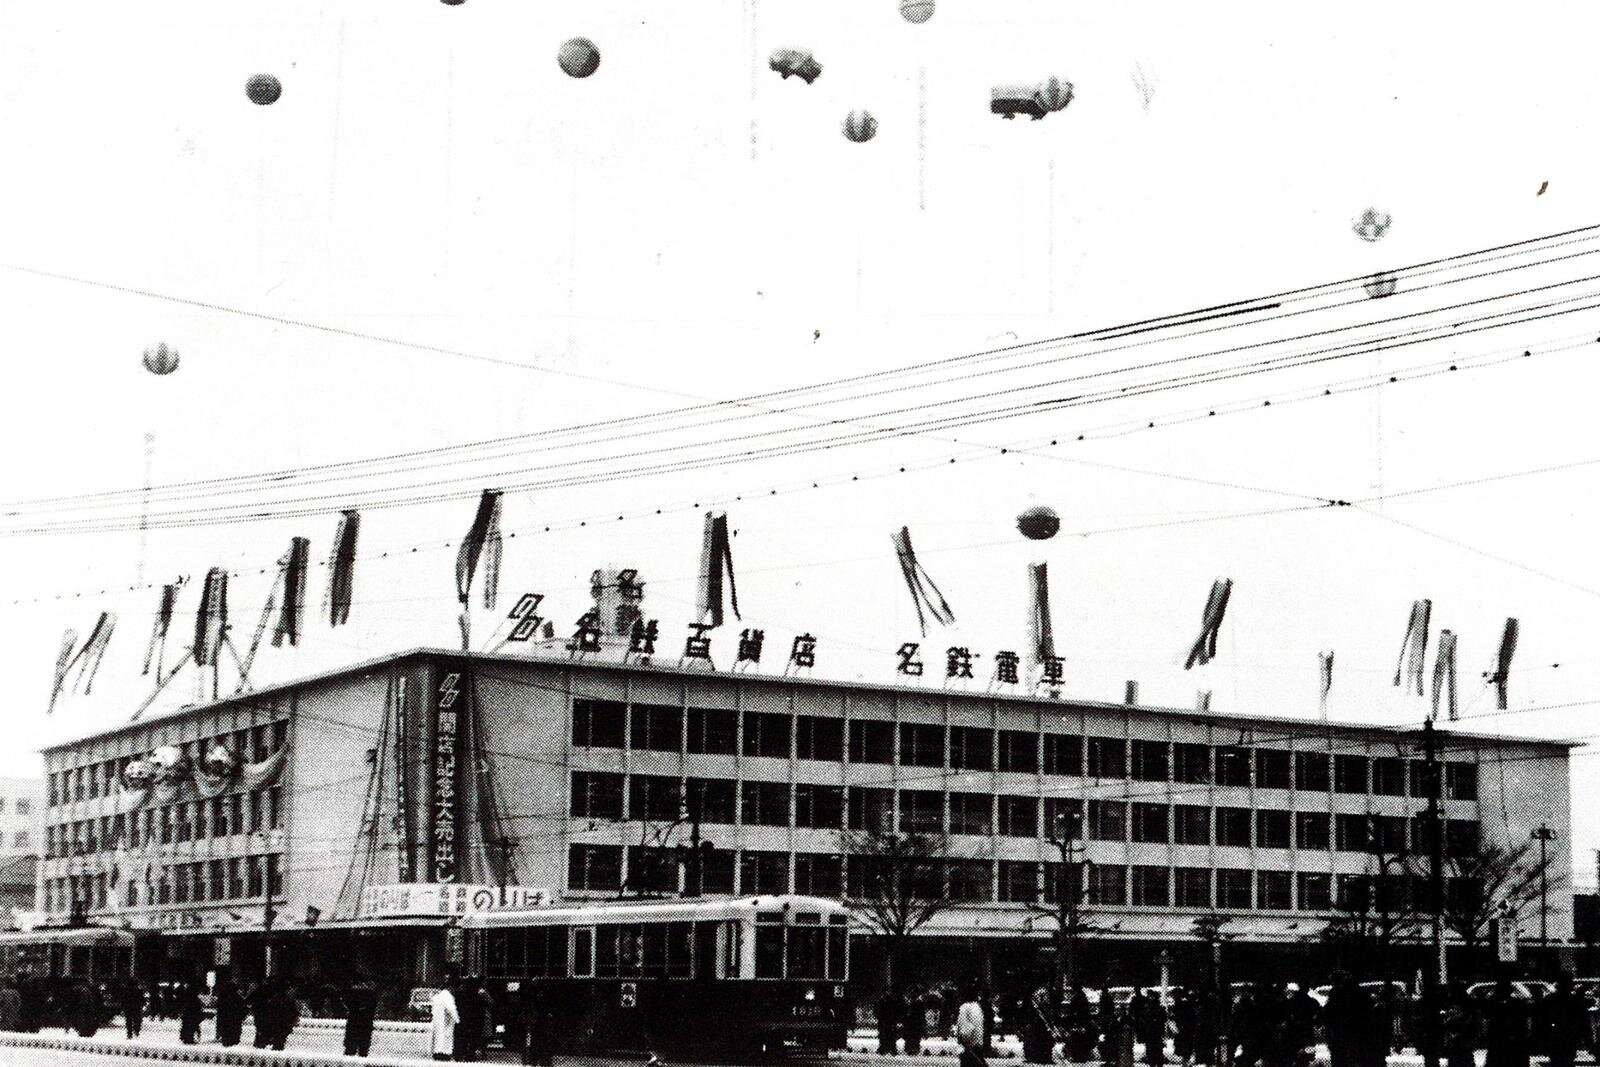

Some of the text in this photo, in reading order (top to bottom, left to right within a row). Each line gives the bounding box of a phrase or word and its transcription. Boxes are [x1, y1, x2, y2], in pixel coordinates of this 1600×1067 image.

[574, 606, 817, 668] 名鉄百貨店
[897, 642, 1066, 686] 名鉄電車
